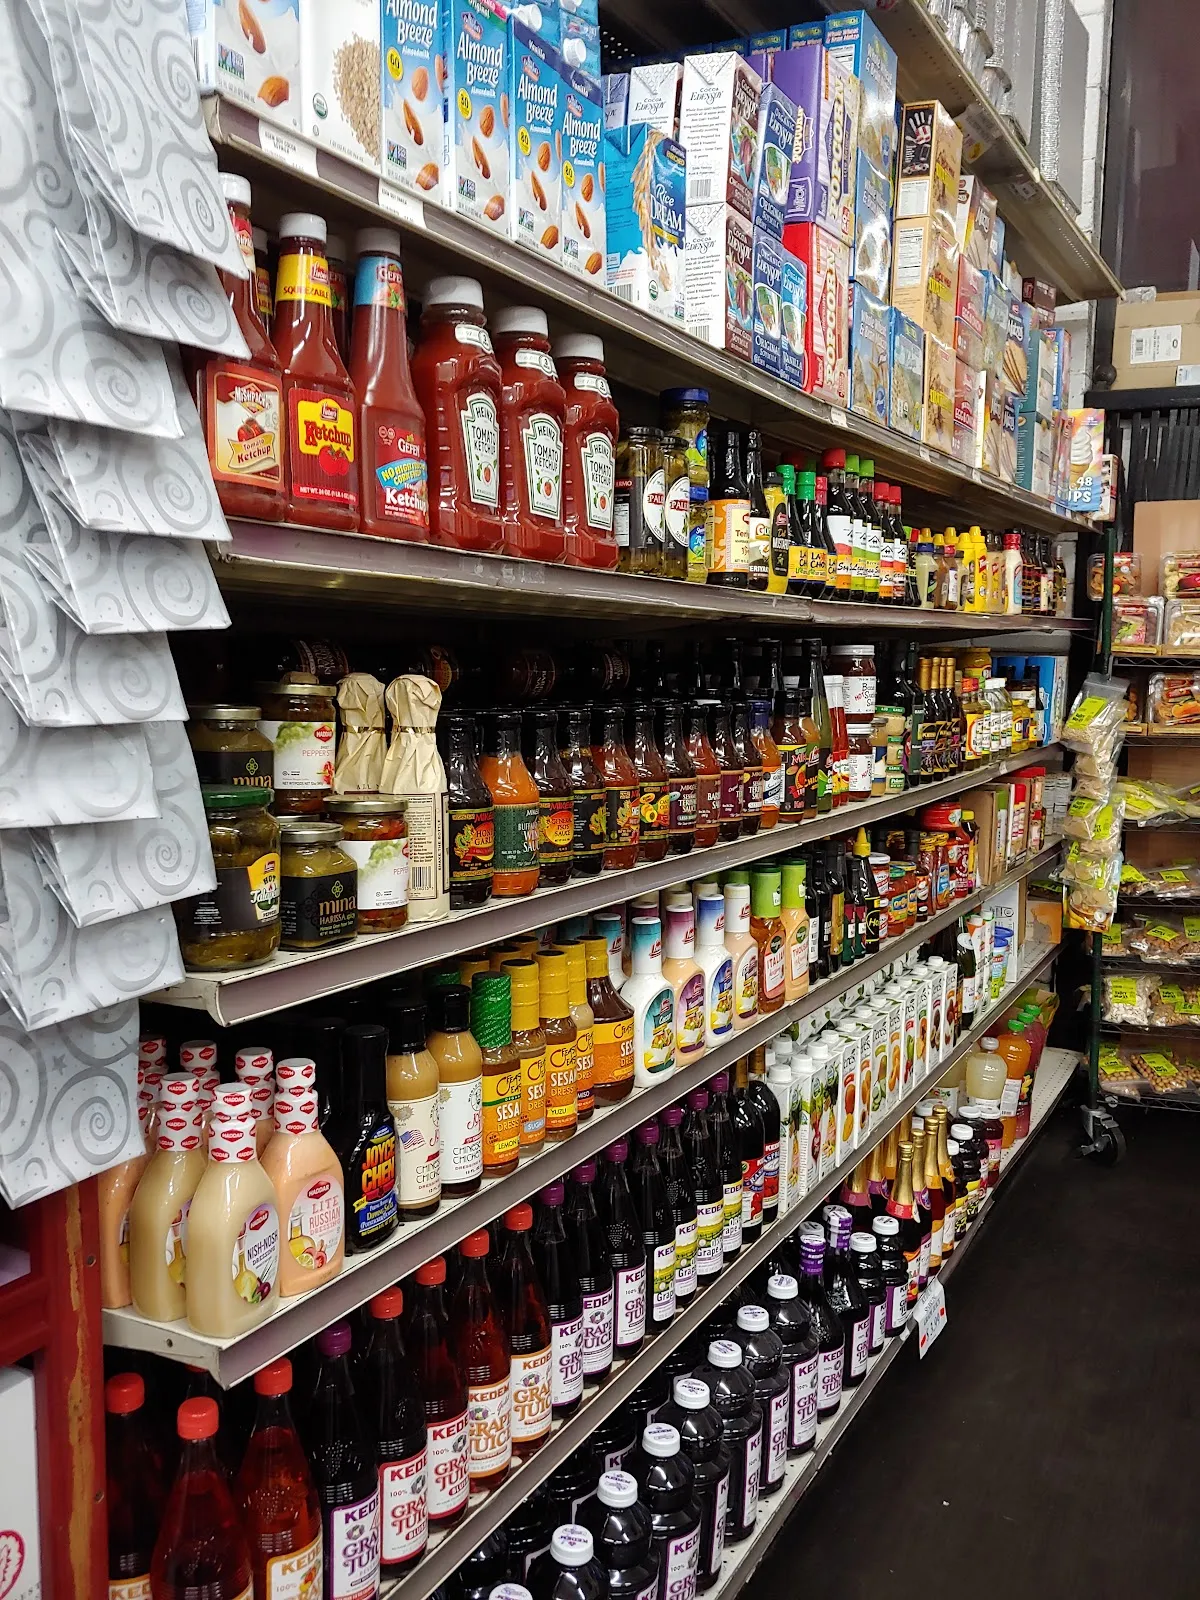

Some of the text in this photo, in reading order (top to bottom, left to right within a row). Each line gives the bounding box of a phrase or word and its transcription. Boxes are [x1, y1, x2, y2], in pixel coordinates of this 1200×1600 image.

[397, 19, 433, 49] Breeze
[457, 32, 504, 70] Almond
[466, 61, 500, 89] Breeze
[517, 73, 558, 109] Almond
[526, 101, 555, 126] Breeze
[562, 111, 601, 143] Almond
[569, 136, 598, 158] Breeze
[828, 76, 845, 220] POPCORN
[656, 188, 675, 206] Rice
[652, 200, 684, 234] DREAM
[825, 247, 836, 384] POPCORN
[475, 406, 494, 427] HEINZ
[304, 420, 352, 451] Ketchup
[471, 425, 496, 445] TOMATO
[536, 425, 556, 441] HEINZ
[237, 445, 271, 464] Ketchup
[243, 439, 265, 452] Tomato
[397, 438, 420, 458] GEFEN
[473, 441, 496, 456] KETCHUP
[533, 442, 559, 462] TOMATO
[593, 444, 610, 457] HEINZ
[534, 456, 558, 473] KETCHUP
[589, 460, 612, 478] TOMATO
[381, 468, 395, 481] NO
[591, 473, 611, 486] KETCHUP
[1077, 476, 1093, 487] 48
[385, 487, 428, 514] Ketchup
[811, 551, 821, 560] LA
[232, 772, 273, 788] mina
[263, 875, 276, 885] HOT
[319, 895, 356, 915] mina
[319, 913, 346, 926] HARISSA
[550, 1069, 577, 1087] SESA
[224, 1096, 246, 1104] HADDAR
[550, 1085, 575, 1096] DRESS
[496, 1102, 521, 1122] SESA
[528, 1098, 545, 1111] DRES
[550, 1107, 567, 1115] YUZU
[221, 1131, 244, 1139] HADDAR
[497, 1119, 519, 1132] DRESS
[362, 1136, 396, 1170] JOYCE
[498, 1139, 517, 1150] LEMON
[361, 1156, 396, 1193] CHEN
[309, 1183, 331, 1197] HADDAR
[723, 1185, 743, 1195] EDEM
[311, 1195, 339, 1214] LITE
[250, 1214, 269, 1229] HADDAR
[309, 1206, 341, 1229] RUSSIAN
[310, 1221, 341, 1236] DRESSING
[247, 1229, 279, 1262] NISH-NOSH
[252, 1246, 276, 1267] DRESSING
[625, 1266, 646, 1284] KED
[678, 1266, 697, 1277] Grap
[583, 1293, 613, 1310] EDEM
[656, 1288, 675, 1302] Grap
[559, 1318, 583, 1338] KED
[583, 1319, 612, 1338] RAPE
[583, 1330, 612, 1350] UICE
[523, 1348, 552, 1371] KEDE
[823, 1346, 844, 1362] KEDE
[798, 1359, 818, 1377] KED
[513, 1395, 552, 1422] JUIC
[432, 1413, 469, 1441] KEDE
[432, 1448, 449, 1456] 100%
[390, 1454, 427, 1482] KEDE
[435, 1466, 469, 1493] JUIC
[390, 1489, 408, 1497] 100%
[345, 1494, 379, 1525] KEDE
[673, 1533, 698, 1556] KED
[281, 1545, 321, 1576] KEDE
[276, 1584, 298, 1593] 100%
